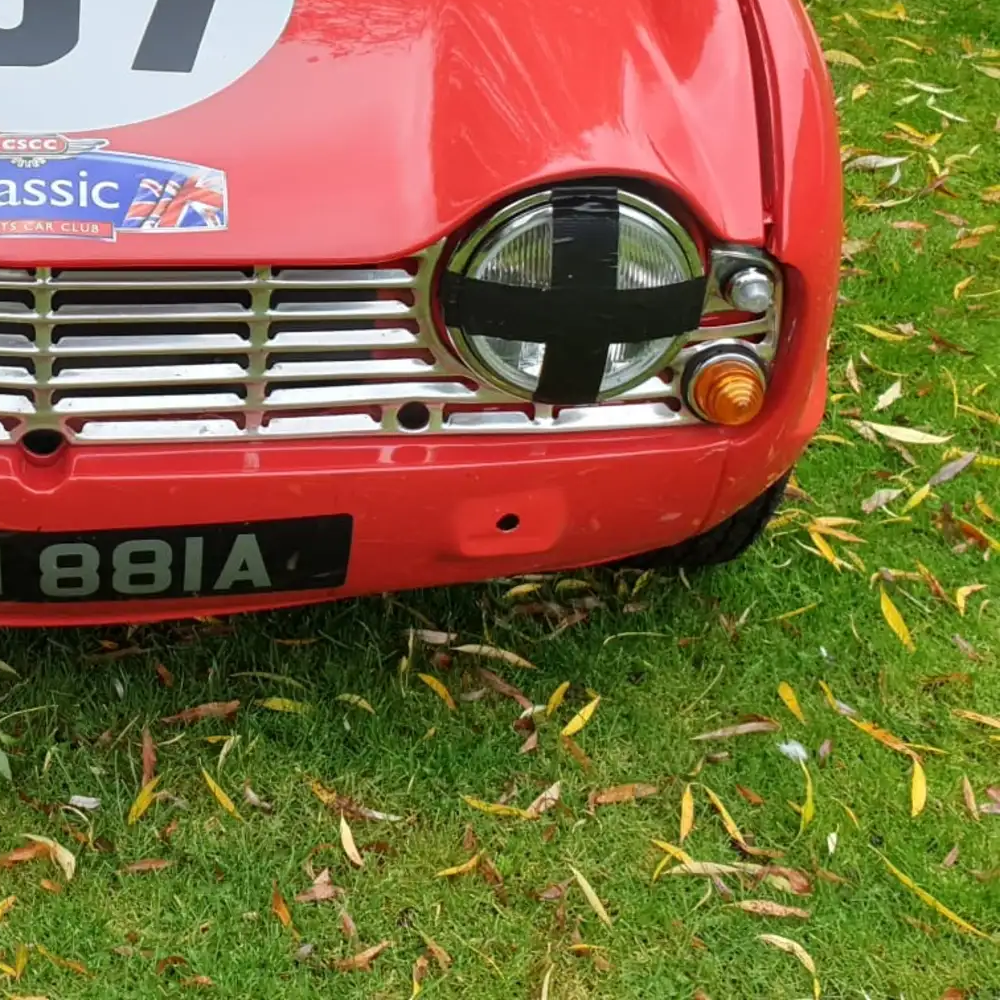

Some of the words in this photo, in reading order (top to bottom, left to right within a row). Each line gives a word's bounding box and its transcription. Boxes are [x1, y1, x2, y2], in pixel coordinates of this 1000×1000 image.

[2, 139, 57, 150] CSCC
[23, 220, 53, 231] CAR
[61, 222, 99, 233] CLUB
[38, 533, 272, 597] 881A
